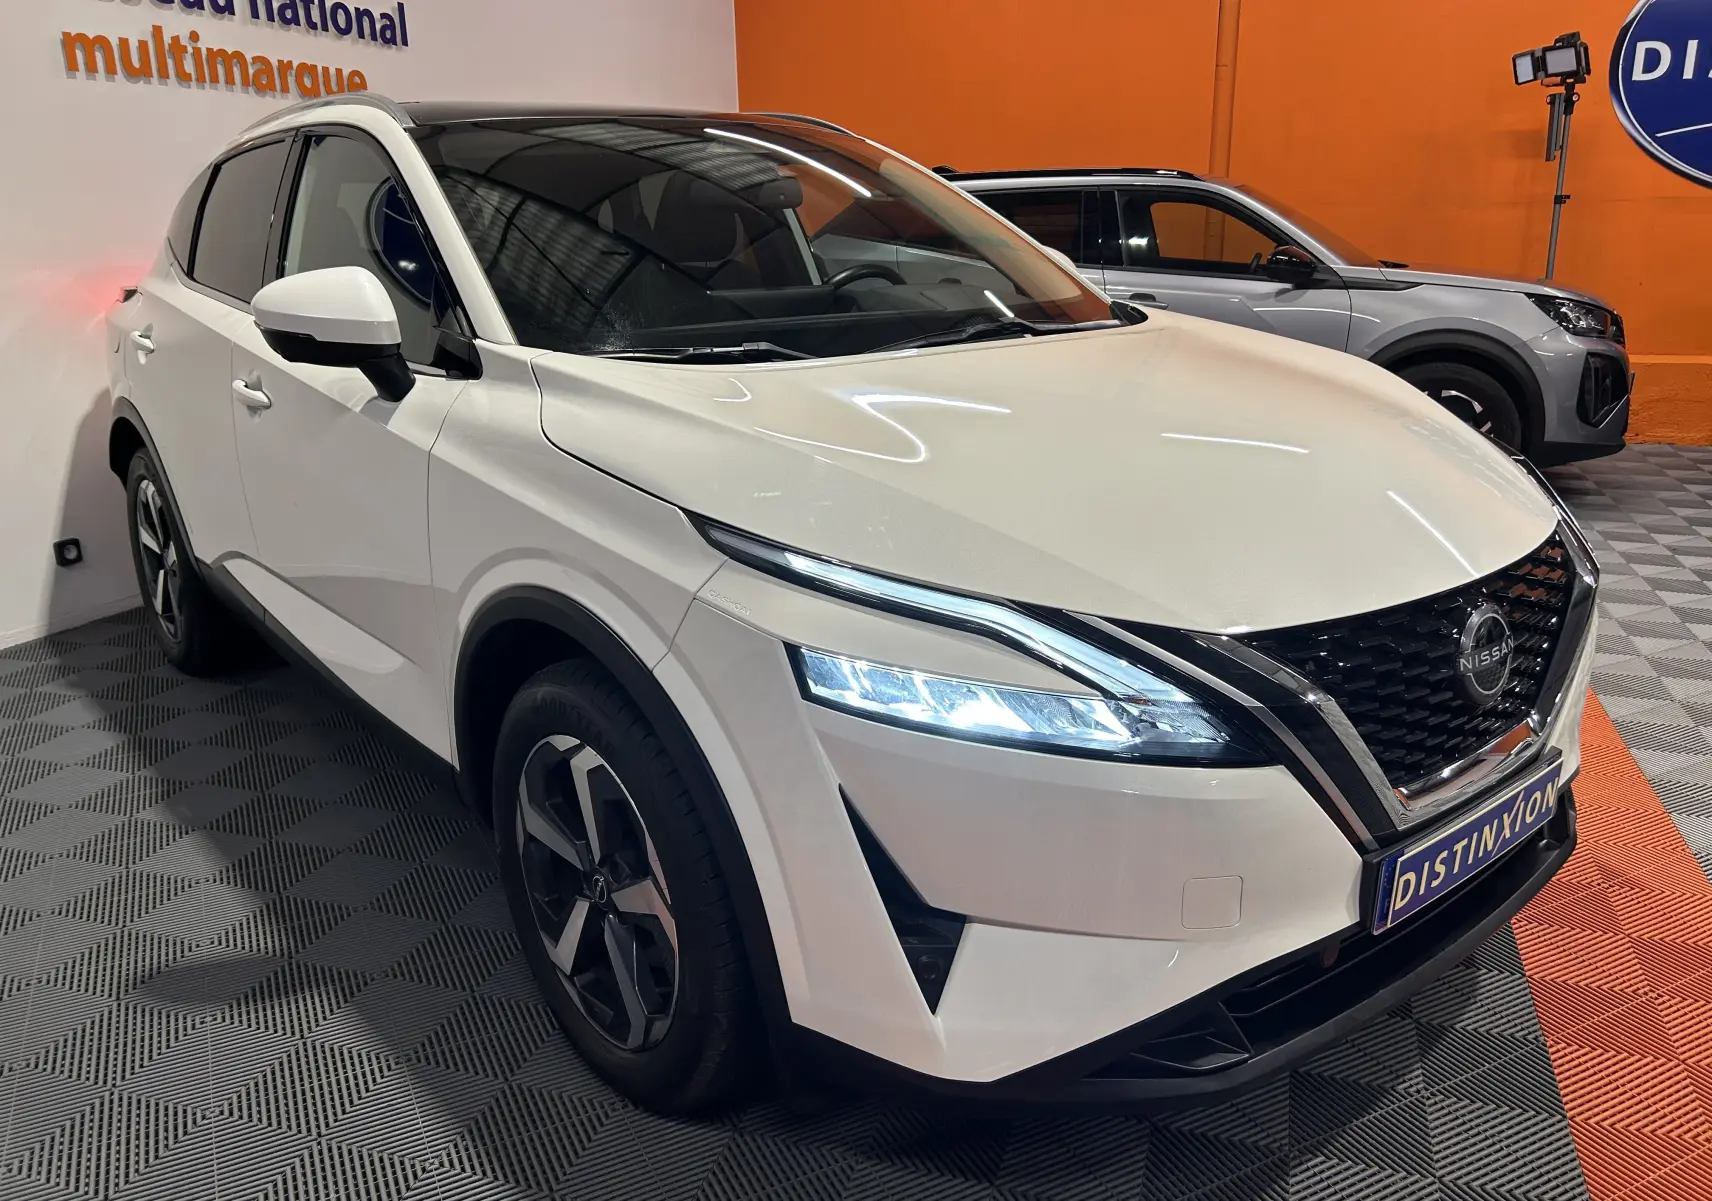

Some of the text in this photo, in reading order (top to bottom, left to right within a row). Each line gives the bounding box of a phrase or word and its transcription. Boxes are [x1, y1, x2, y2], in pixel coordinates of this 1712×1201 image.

[249, 0, 409, 47] national
[61, 24, 368, 97] multimarque
[1632, 39, 1712, 81] DI
[1459, 635, 1514, 671] NISSAN
[1394, 776, 1560, 911] DISTINXION
